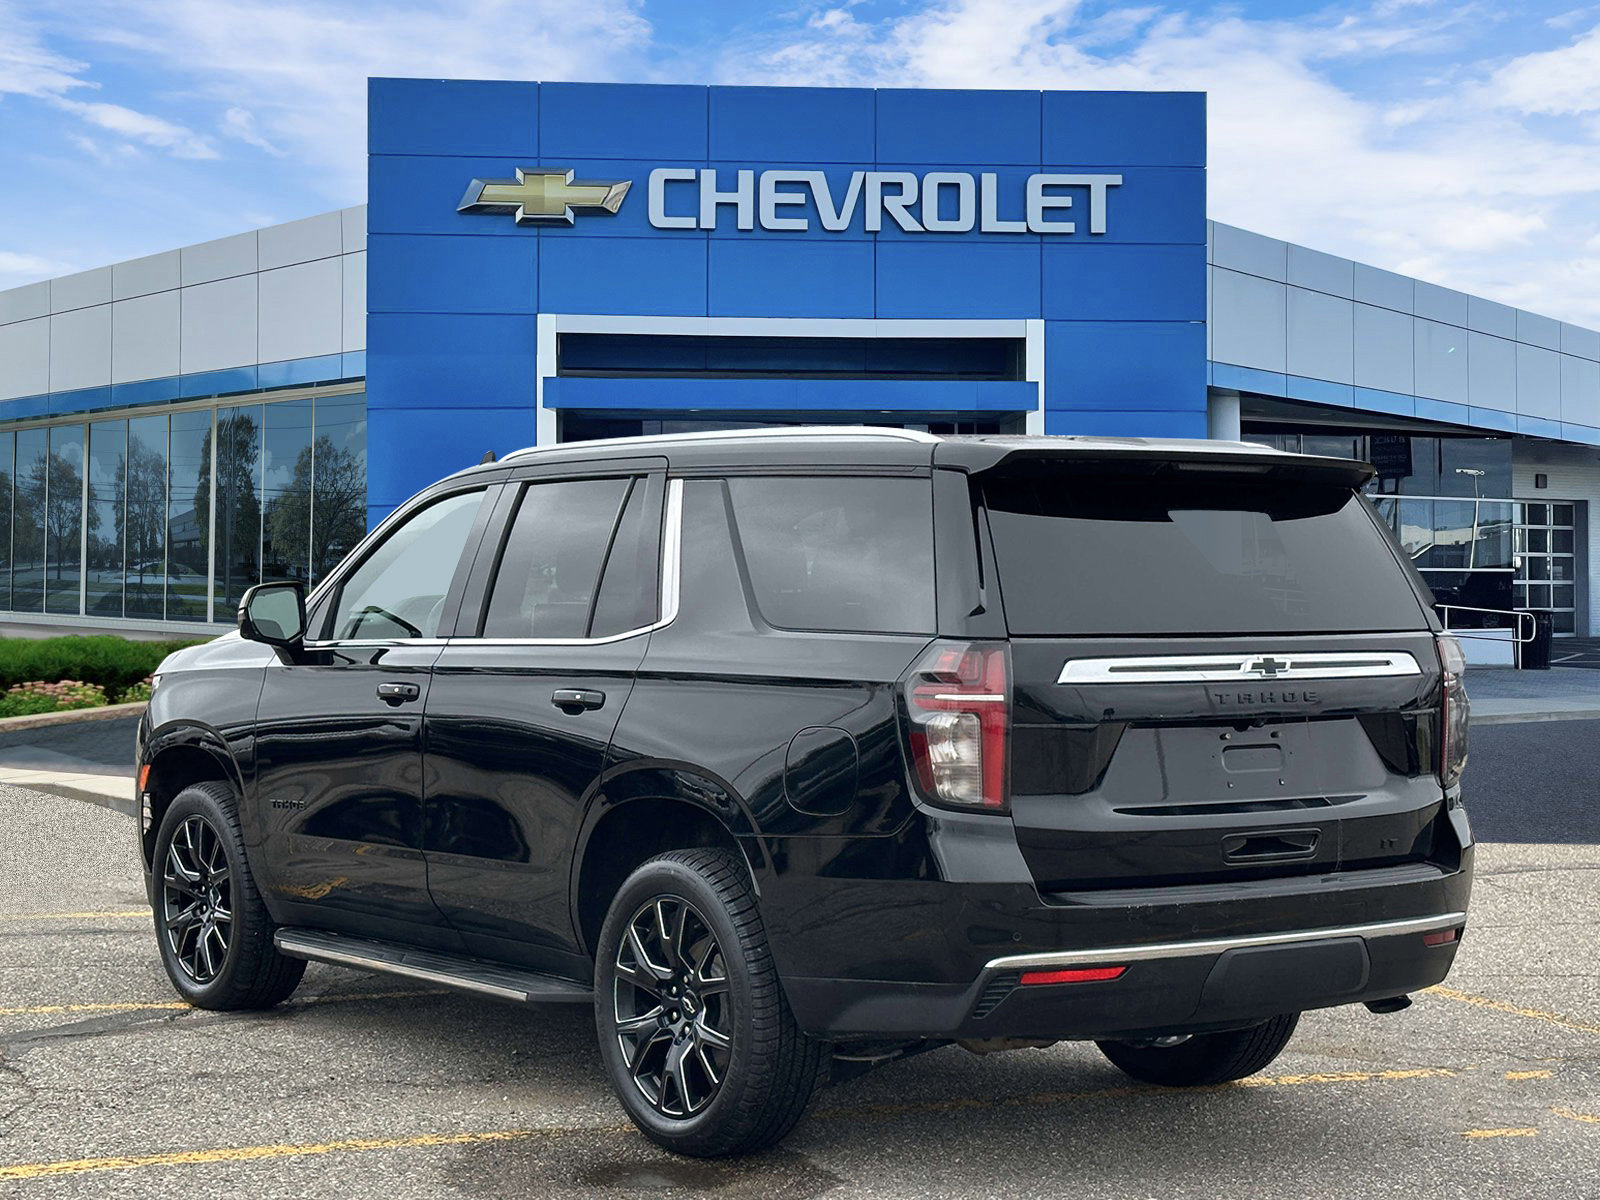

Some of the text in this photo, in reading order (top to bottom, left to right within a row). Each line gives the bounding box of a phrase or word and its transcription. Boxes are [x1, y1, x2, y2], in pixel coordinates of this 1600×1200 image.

[648, 167, 1123, 234] CHEVROLET
[1214, 691, 1319, 705] TAHOE
[270, 798, 306, 810] TAHOE
